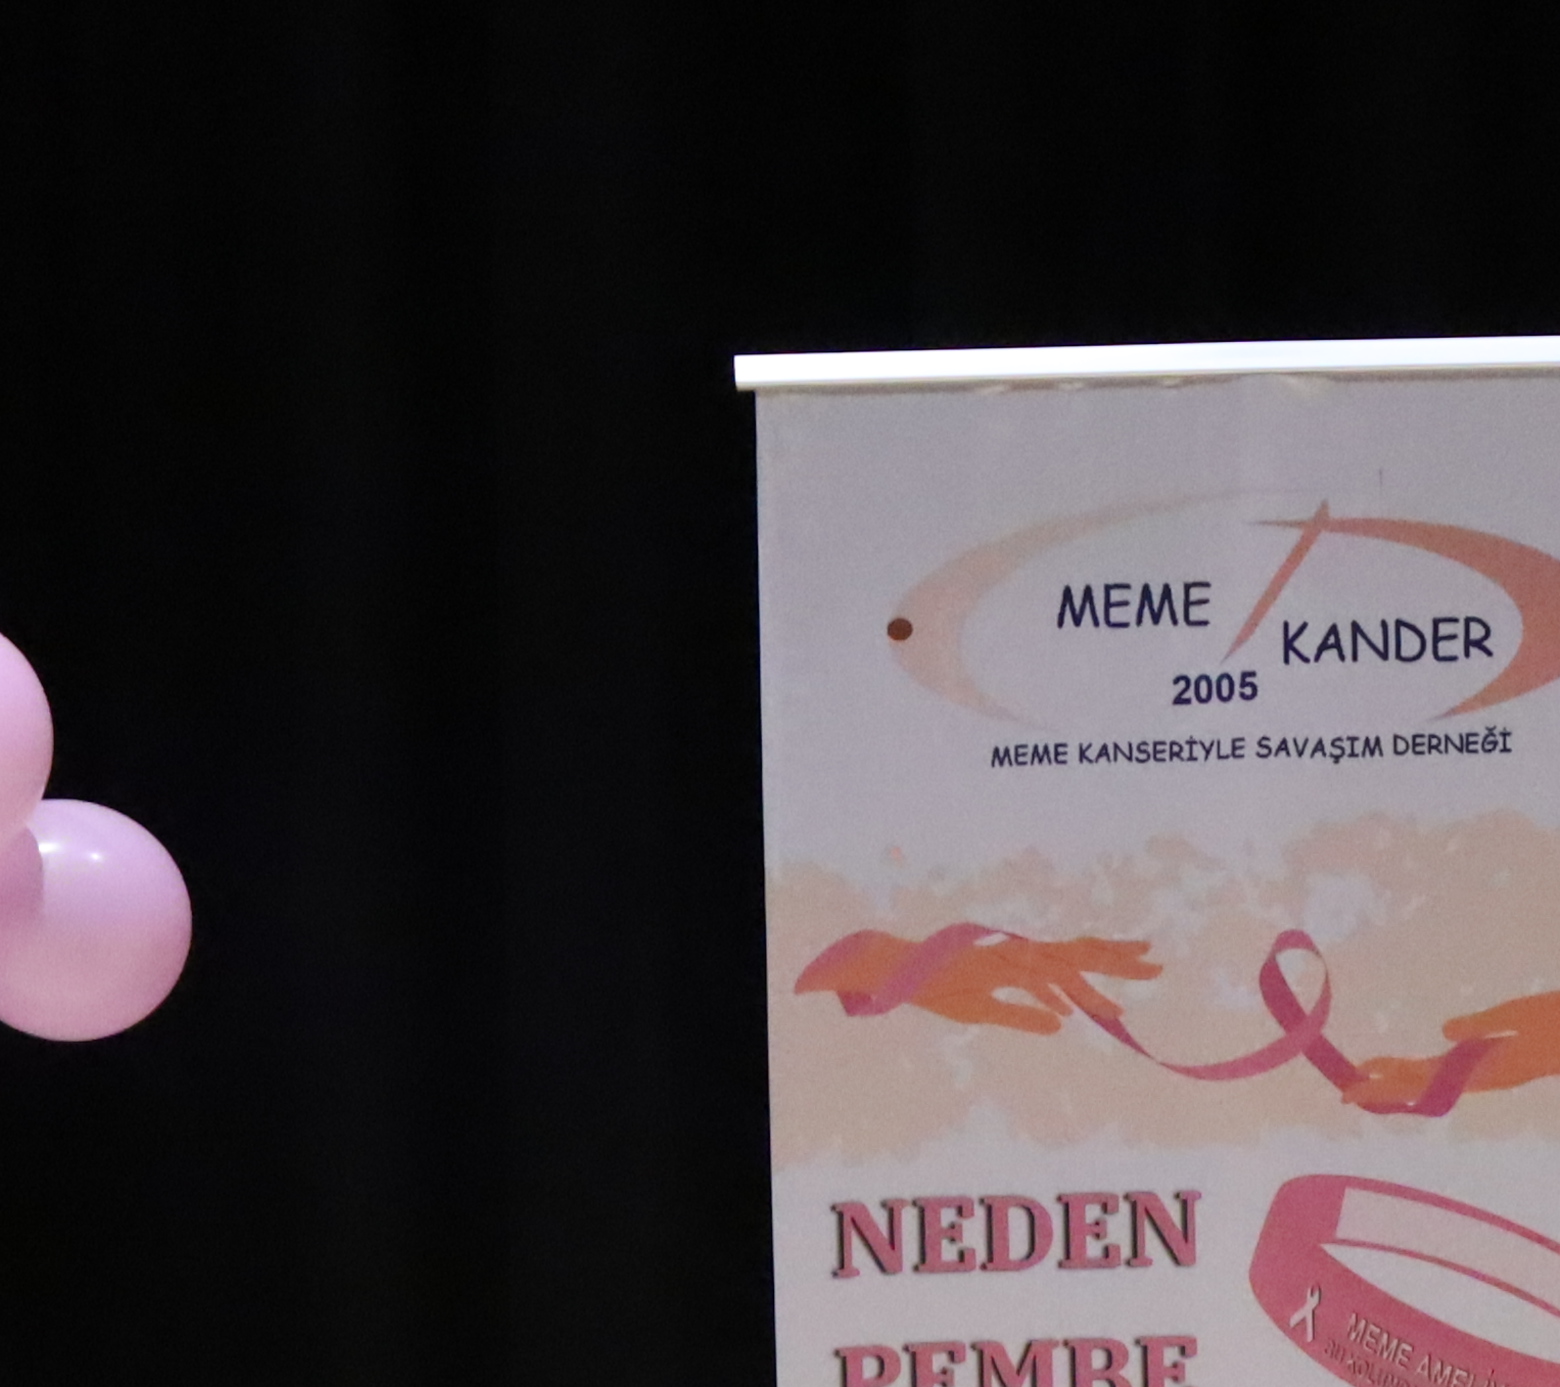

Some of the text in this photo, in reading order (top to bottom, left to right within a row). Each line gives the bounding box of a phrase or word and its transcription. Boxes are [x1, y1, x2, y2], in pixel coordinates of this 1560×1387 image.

[1056, 581, 1211, 629] MEME
[1282, 616, 1494, 665] KANDER
[1172, 670, 1259, 706] 2005
[990, 725, 1512, 768] MEME KANSERİYLE SAVAŞIM DERNEĞİ
[830, 1191, 1201, 1279] NEDEN
[1347, 1312, 1414, 1369] MEME
